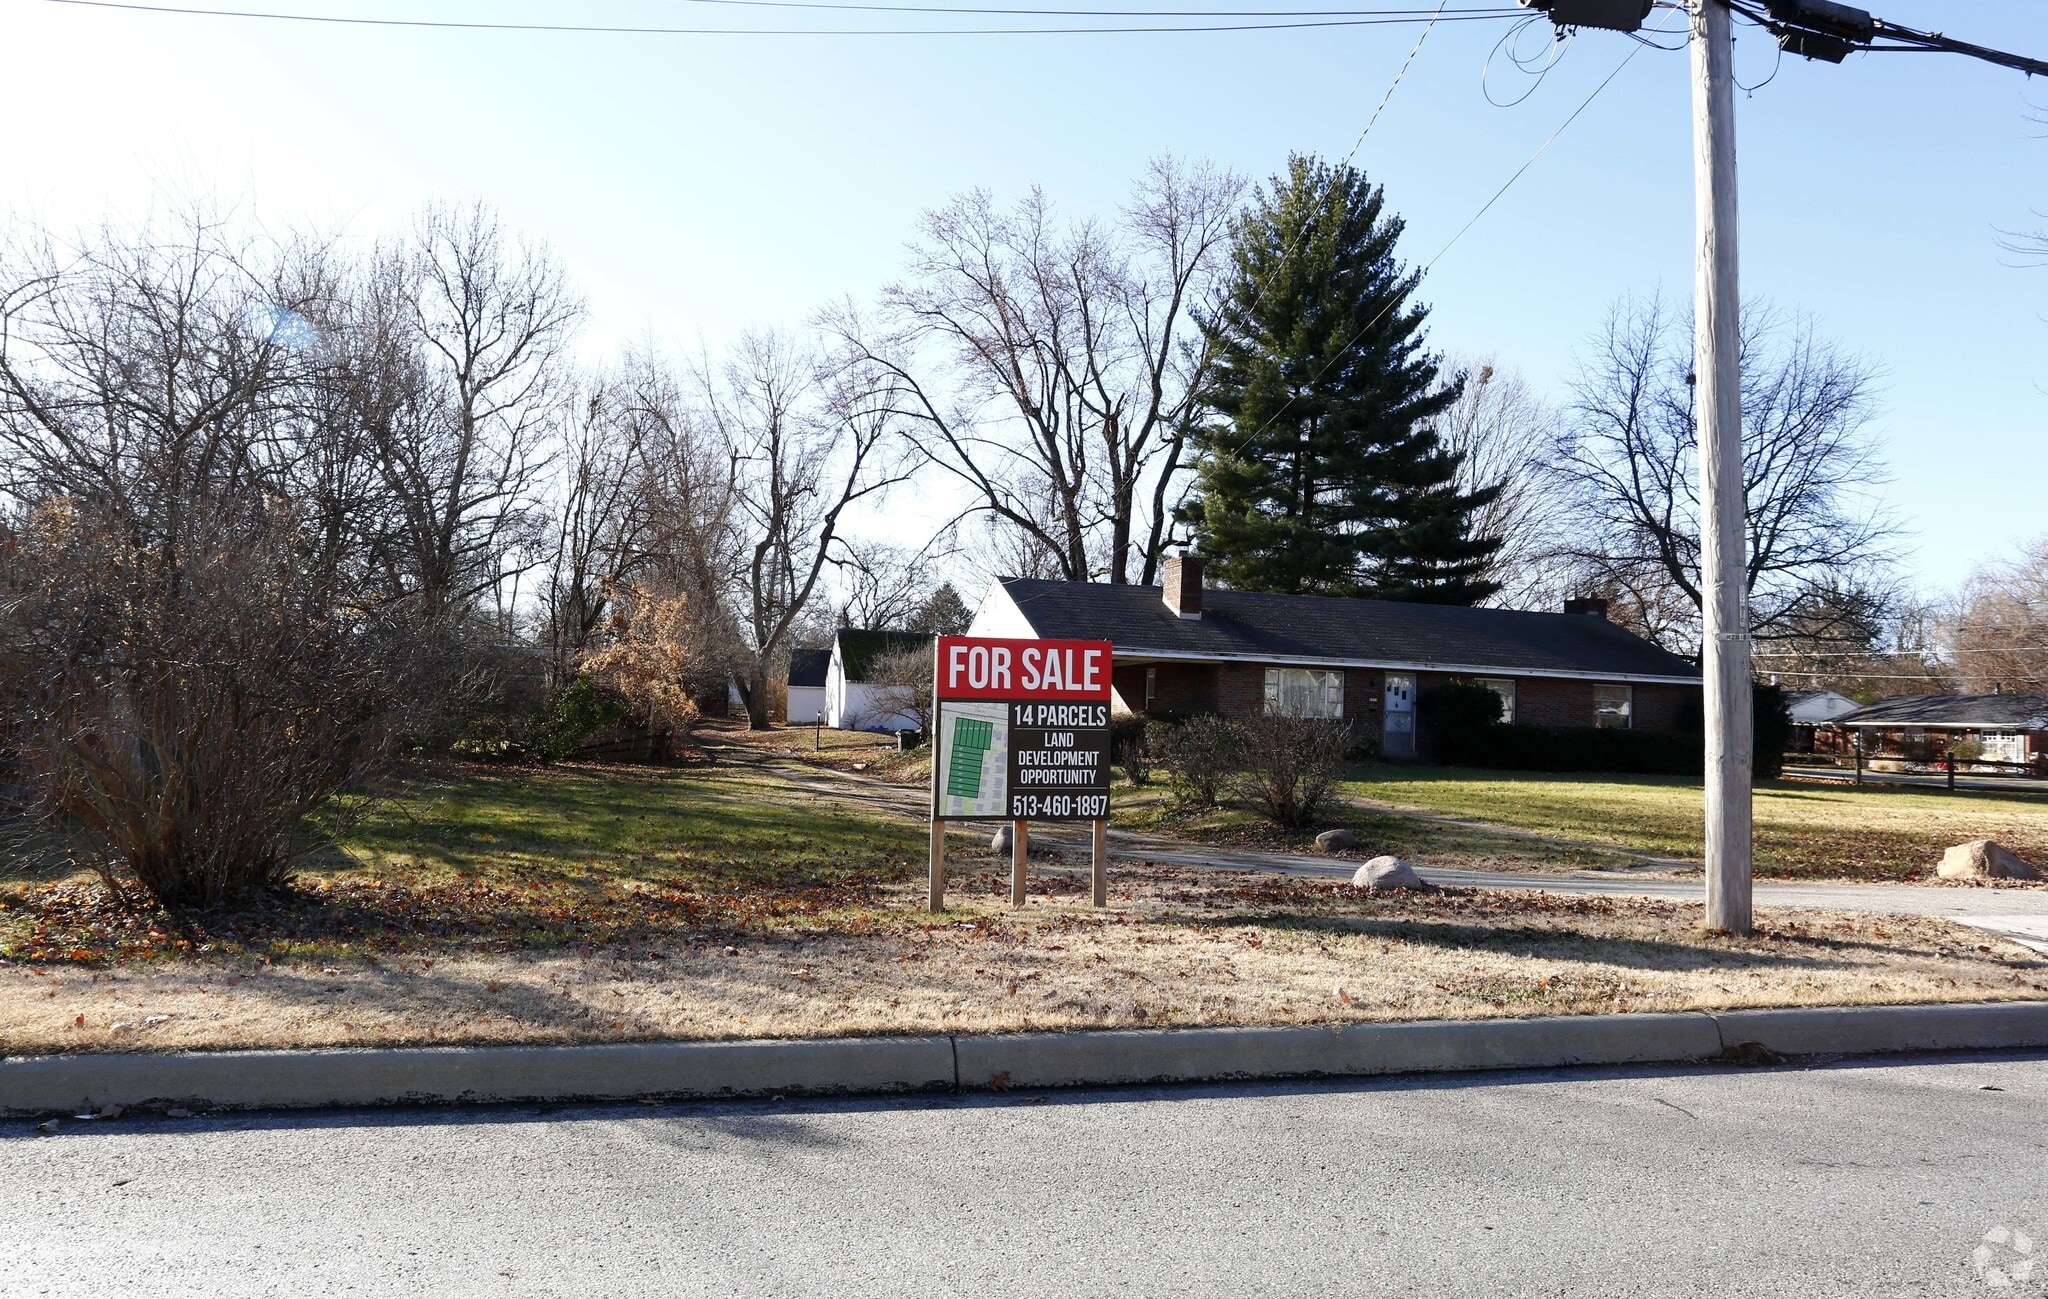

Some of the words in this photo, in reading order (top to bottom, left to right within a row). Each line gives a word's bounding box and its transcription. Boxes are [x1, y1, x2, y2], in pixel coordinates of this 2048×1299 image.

[949, 646, 1011, 689] FOR
[1022, 648, 1101, 691] SALE
[1015, 705, 1033, 726] 14
[1038, 706, 1106, 726] PARCELS
[1045, 733, 1073, 747] LAND
[1019, 751, 1099, 766] DEVELOPMENT
[1021, 769, 1096, 784] OPPORTUNITY
[1013, 795, 1107, 816] 513-460-1897
